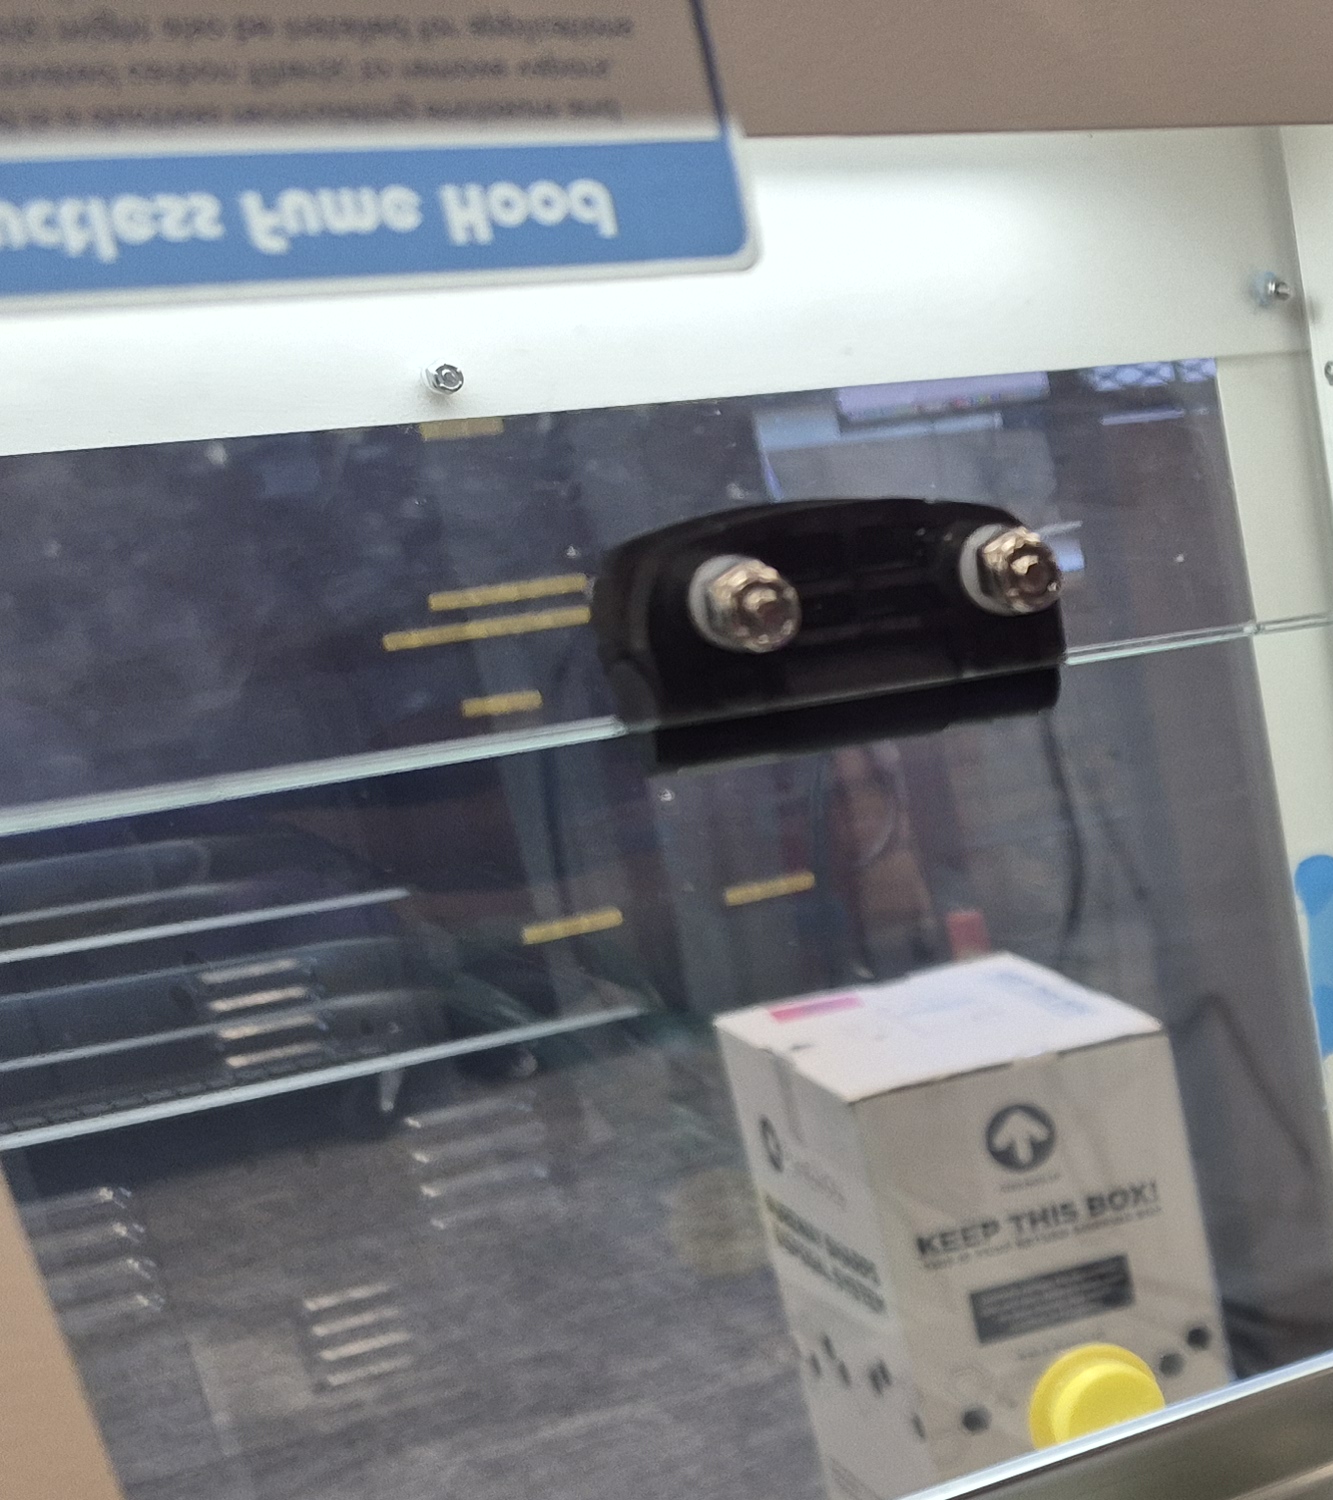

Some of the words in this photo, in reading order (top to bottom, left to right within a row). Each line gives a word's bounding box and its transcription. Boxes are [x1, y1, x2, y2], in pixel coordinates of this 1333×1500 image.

[917, 1220, 1000, 1256] KEEP
[1009, 1202, 1079, 1236] THIS
[1085, 1180, 1159, 1217] BOX!
